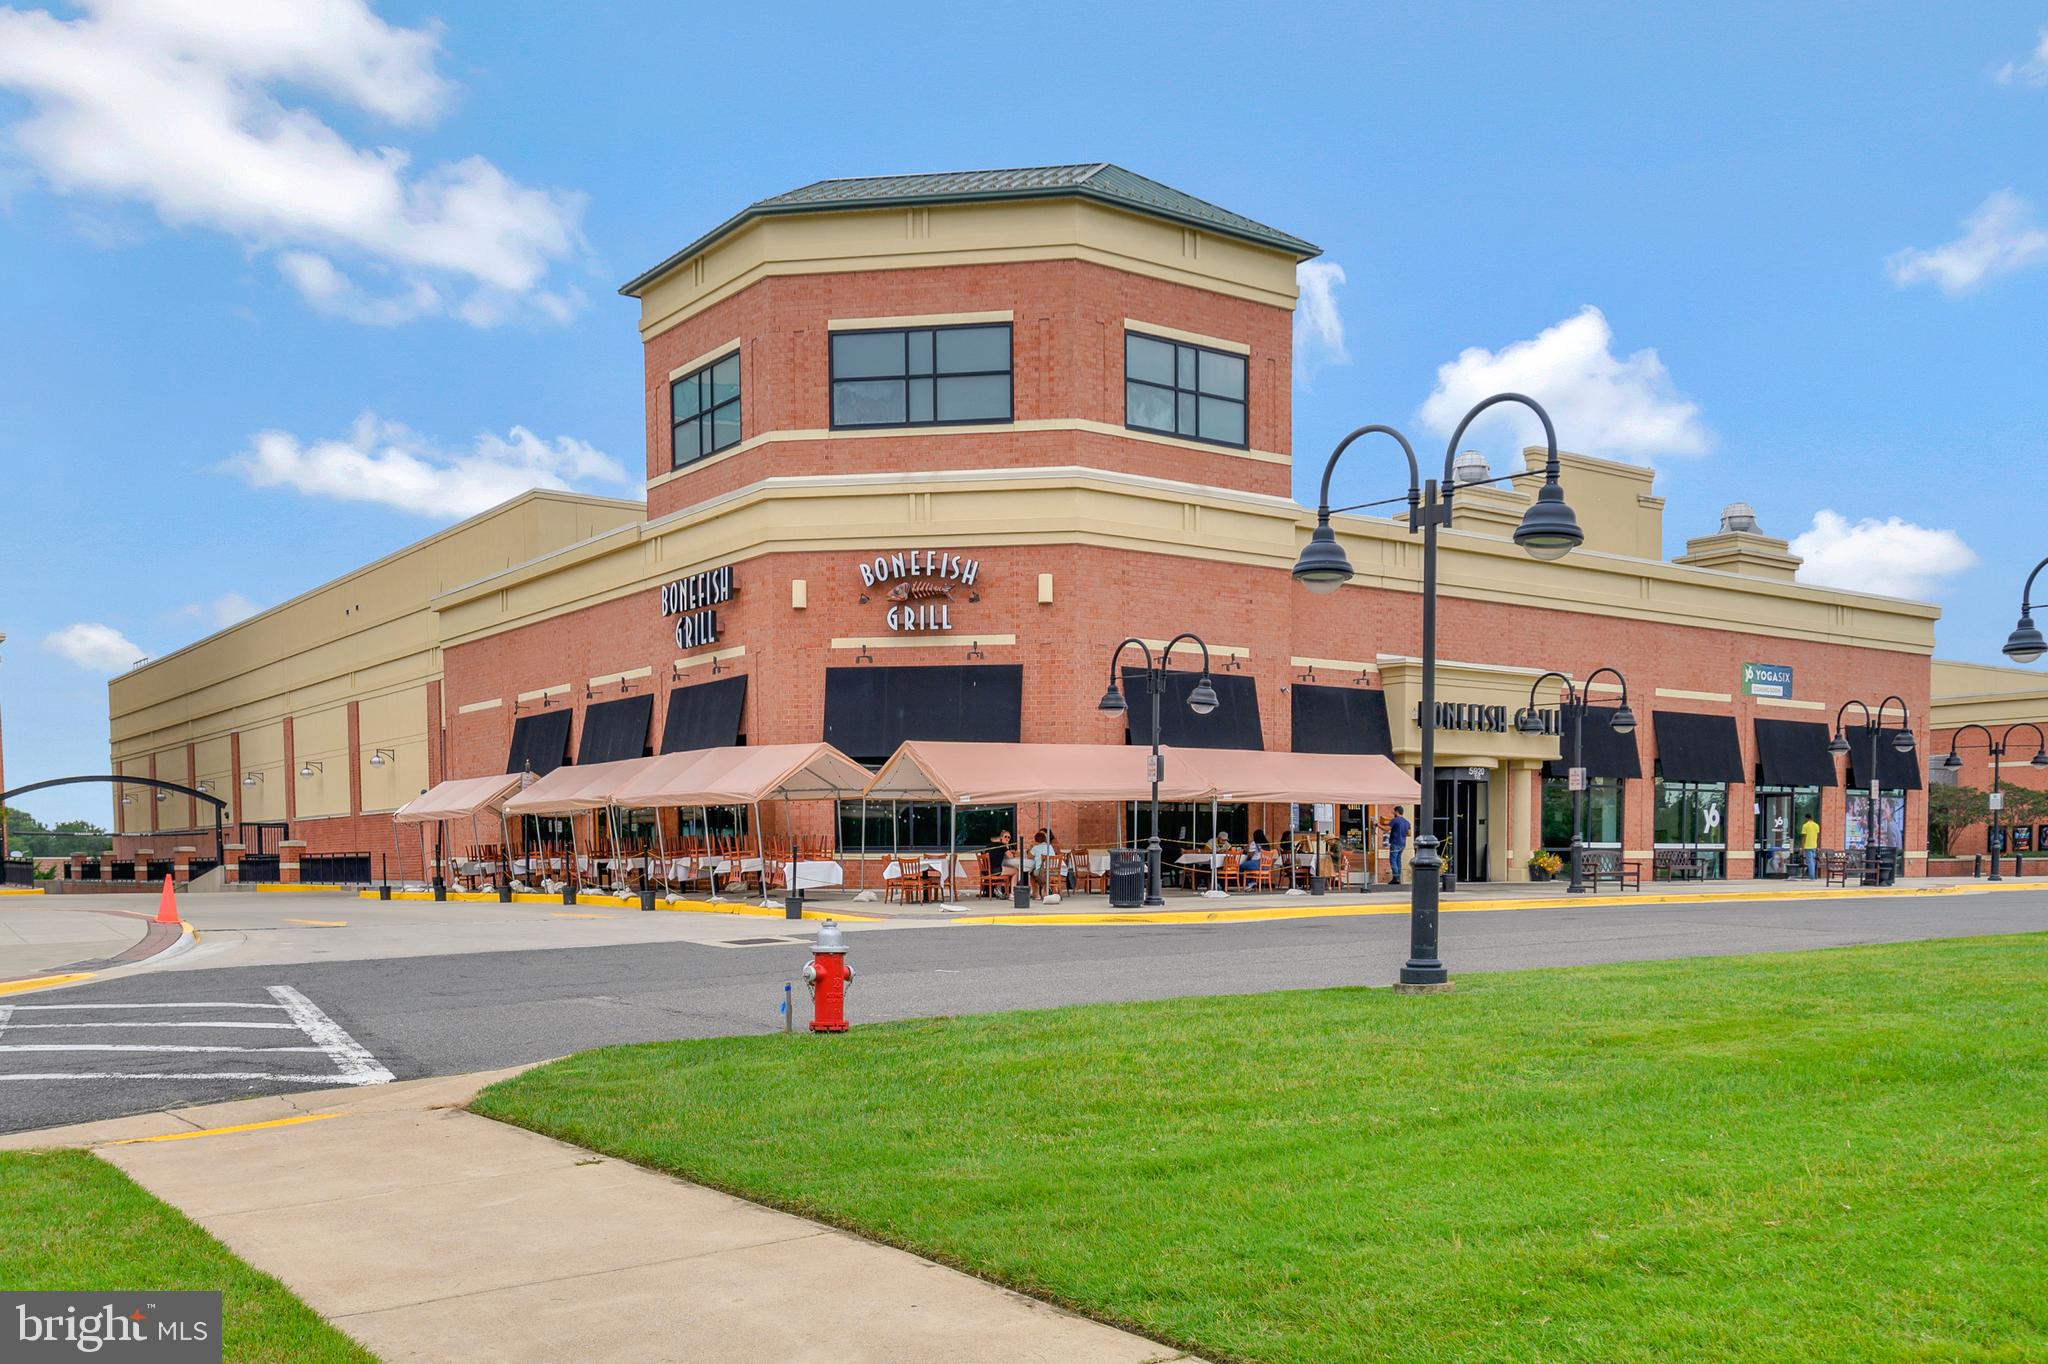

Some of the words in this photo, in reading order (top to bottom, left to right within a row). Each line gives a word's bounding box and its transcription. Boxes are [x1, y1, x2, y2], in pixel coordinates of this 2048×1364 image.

[859, 550, 979, 587] BONEFISH
[661, 565, 731, 617] BONEFISH
[675, 609, 716, 649] GRILL
[886, 604, 952, 631] GRILL
[1756, 669, 1791, 683] YOGASIX
[1514, 707, 1565, 736] GILL
